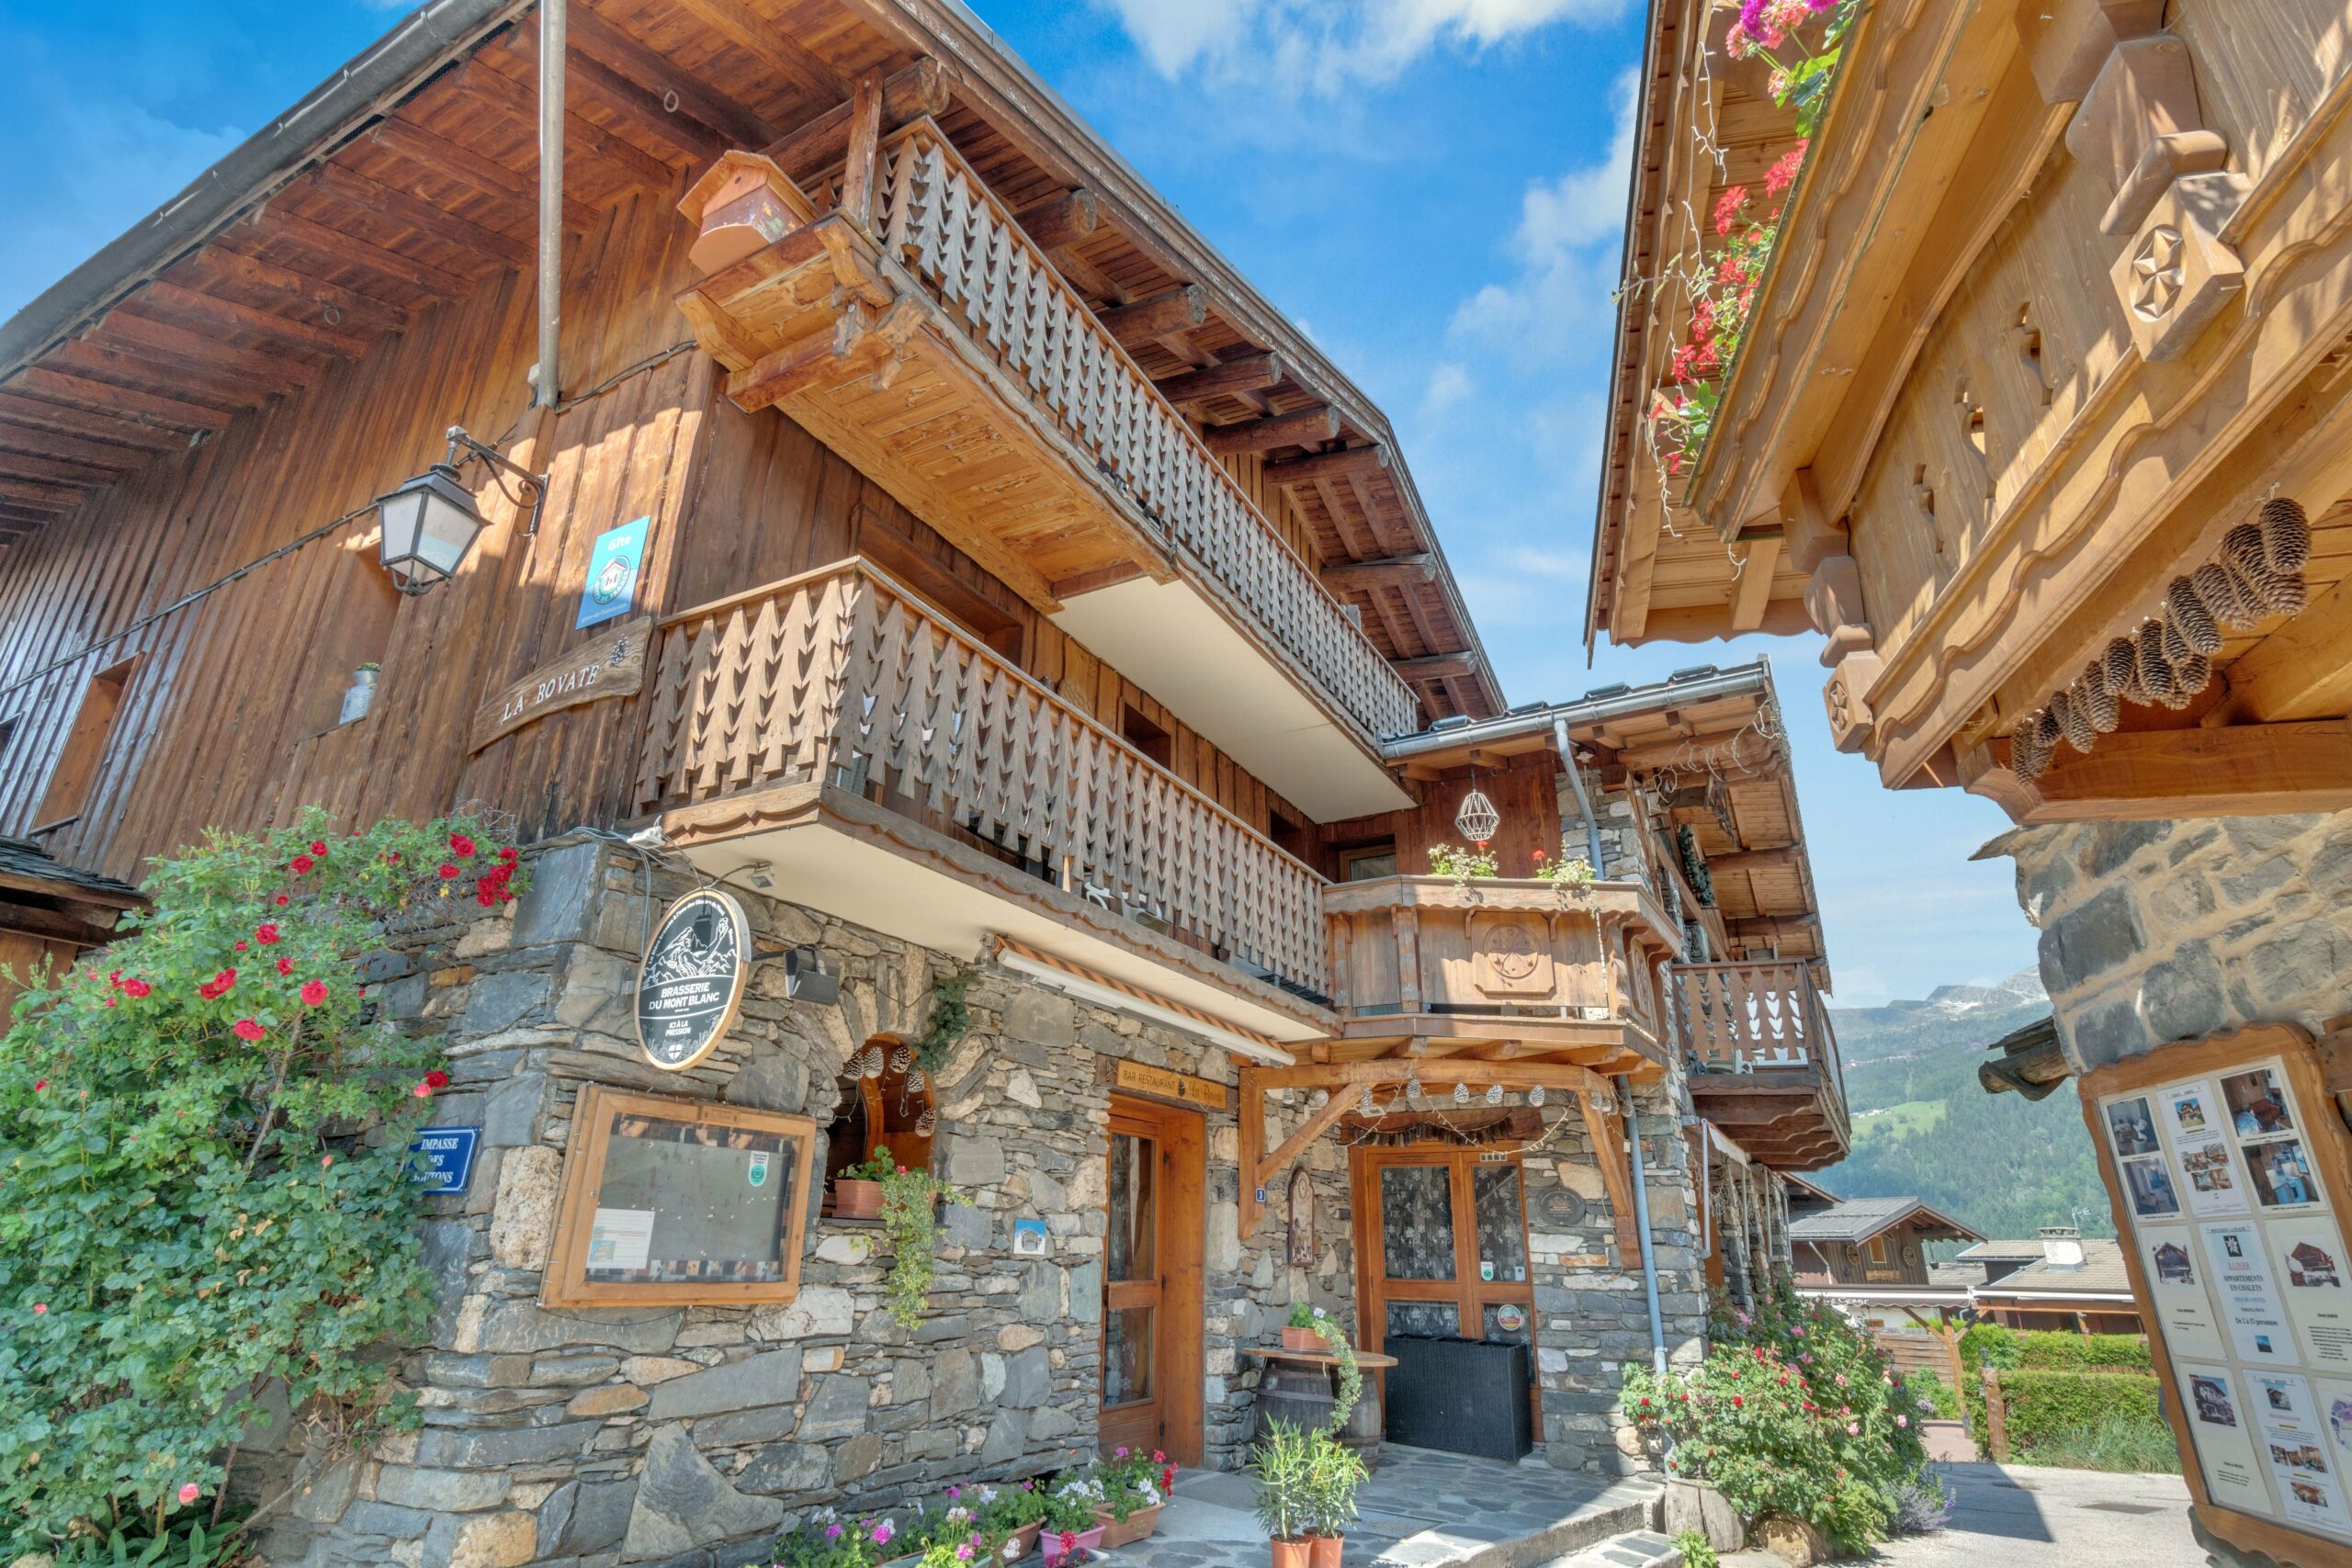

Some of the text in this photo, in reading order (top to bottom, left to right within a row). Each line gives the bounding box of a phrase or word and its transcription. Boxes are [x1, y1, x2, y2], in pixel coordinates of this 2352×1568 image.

[502, 665, 600, 722] LA BOVATE
[661, 982, 711, 998] BRASSERIE
[649, 991, 720, 1010] DU MONT BLANC
[681, 1020, 689, 1028] LA
[665, 1026, 692, 1037] PRESSION
[1123, 1069, 1136, 1082] BAR
[1138, 1073, 1176, 1091] RESTAURANT
[421, 1138, 458, 1150] IMPASSE
[412, 1171, 454, 1183] OUTONS
